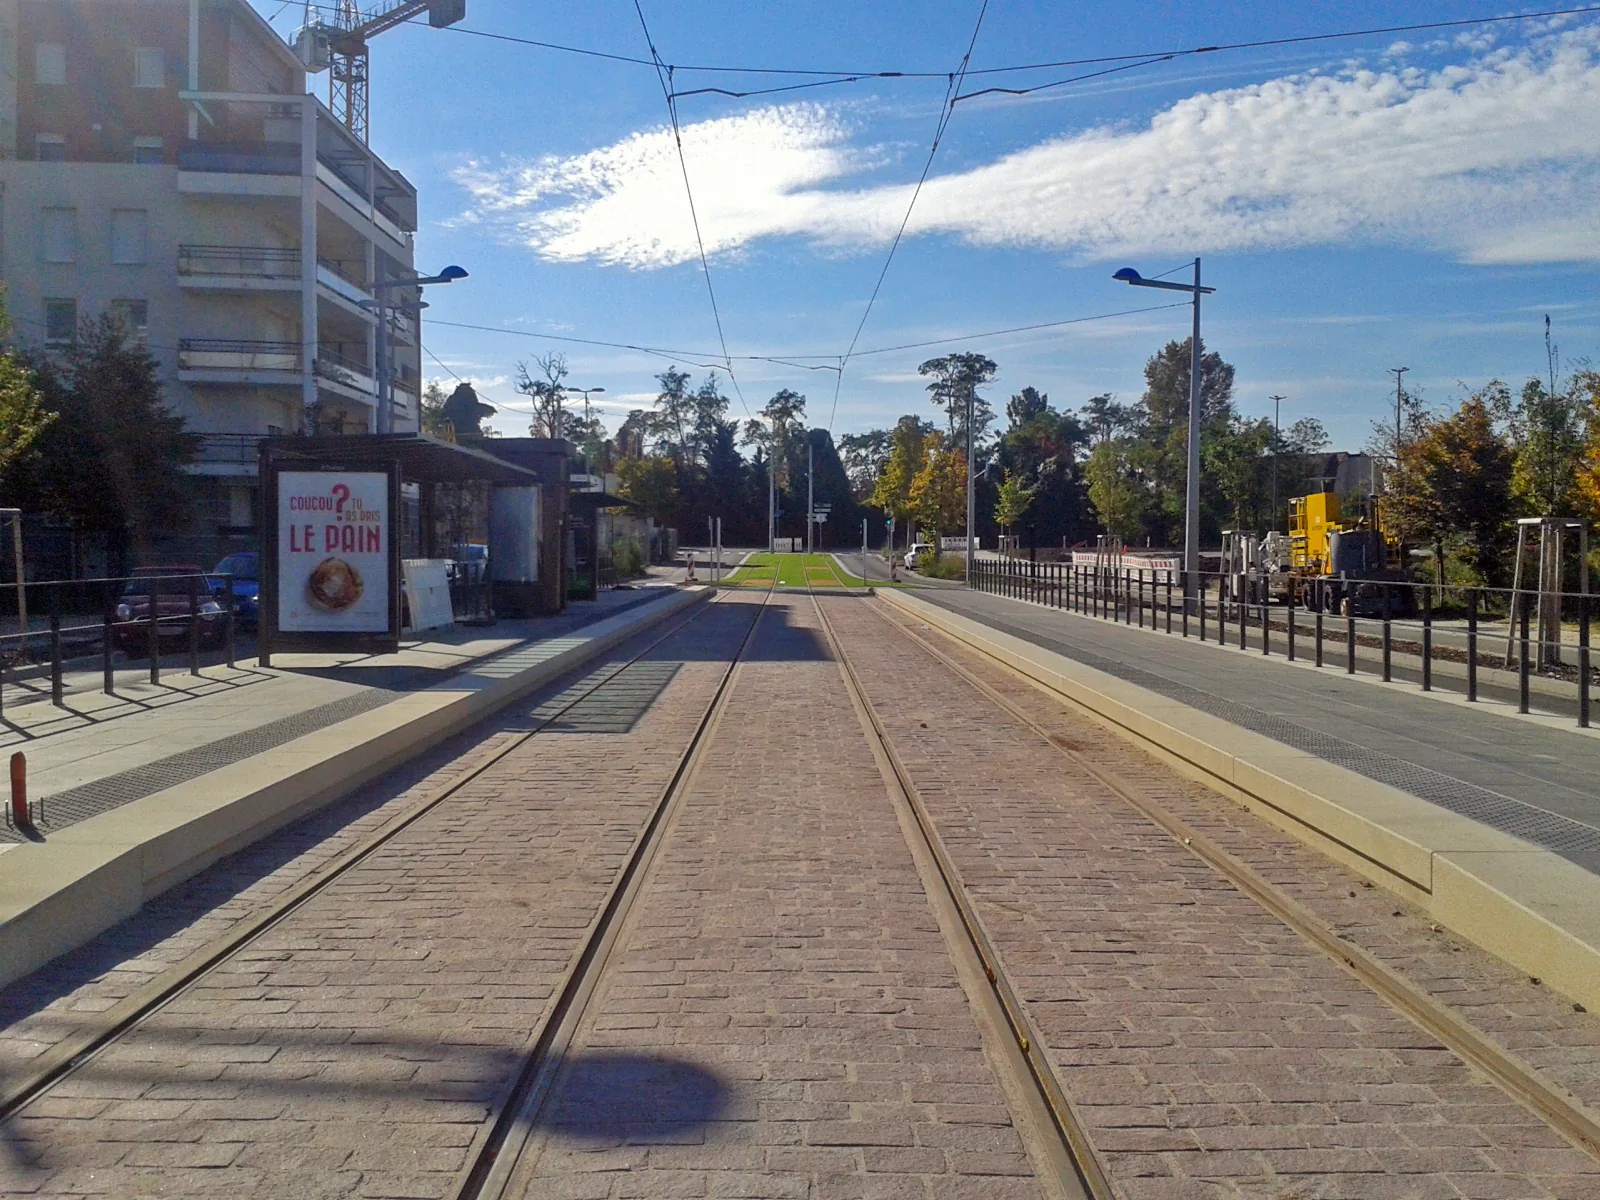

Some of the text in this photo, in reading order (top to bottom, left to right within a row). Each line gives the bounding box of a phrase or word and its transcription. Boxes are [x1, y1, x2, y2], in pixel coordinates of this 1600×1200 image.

[290, 496, 333, 510] COUCOU
[352, 498, 363, 510] TU
[290, 525, 380, 552] LE PAIN
